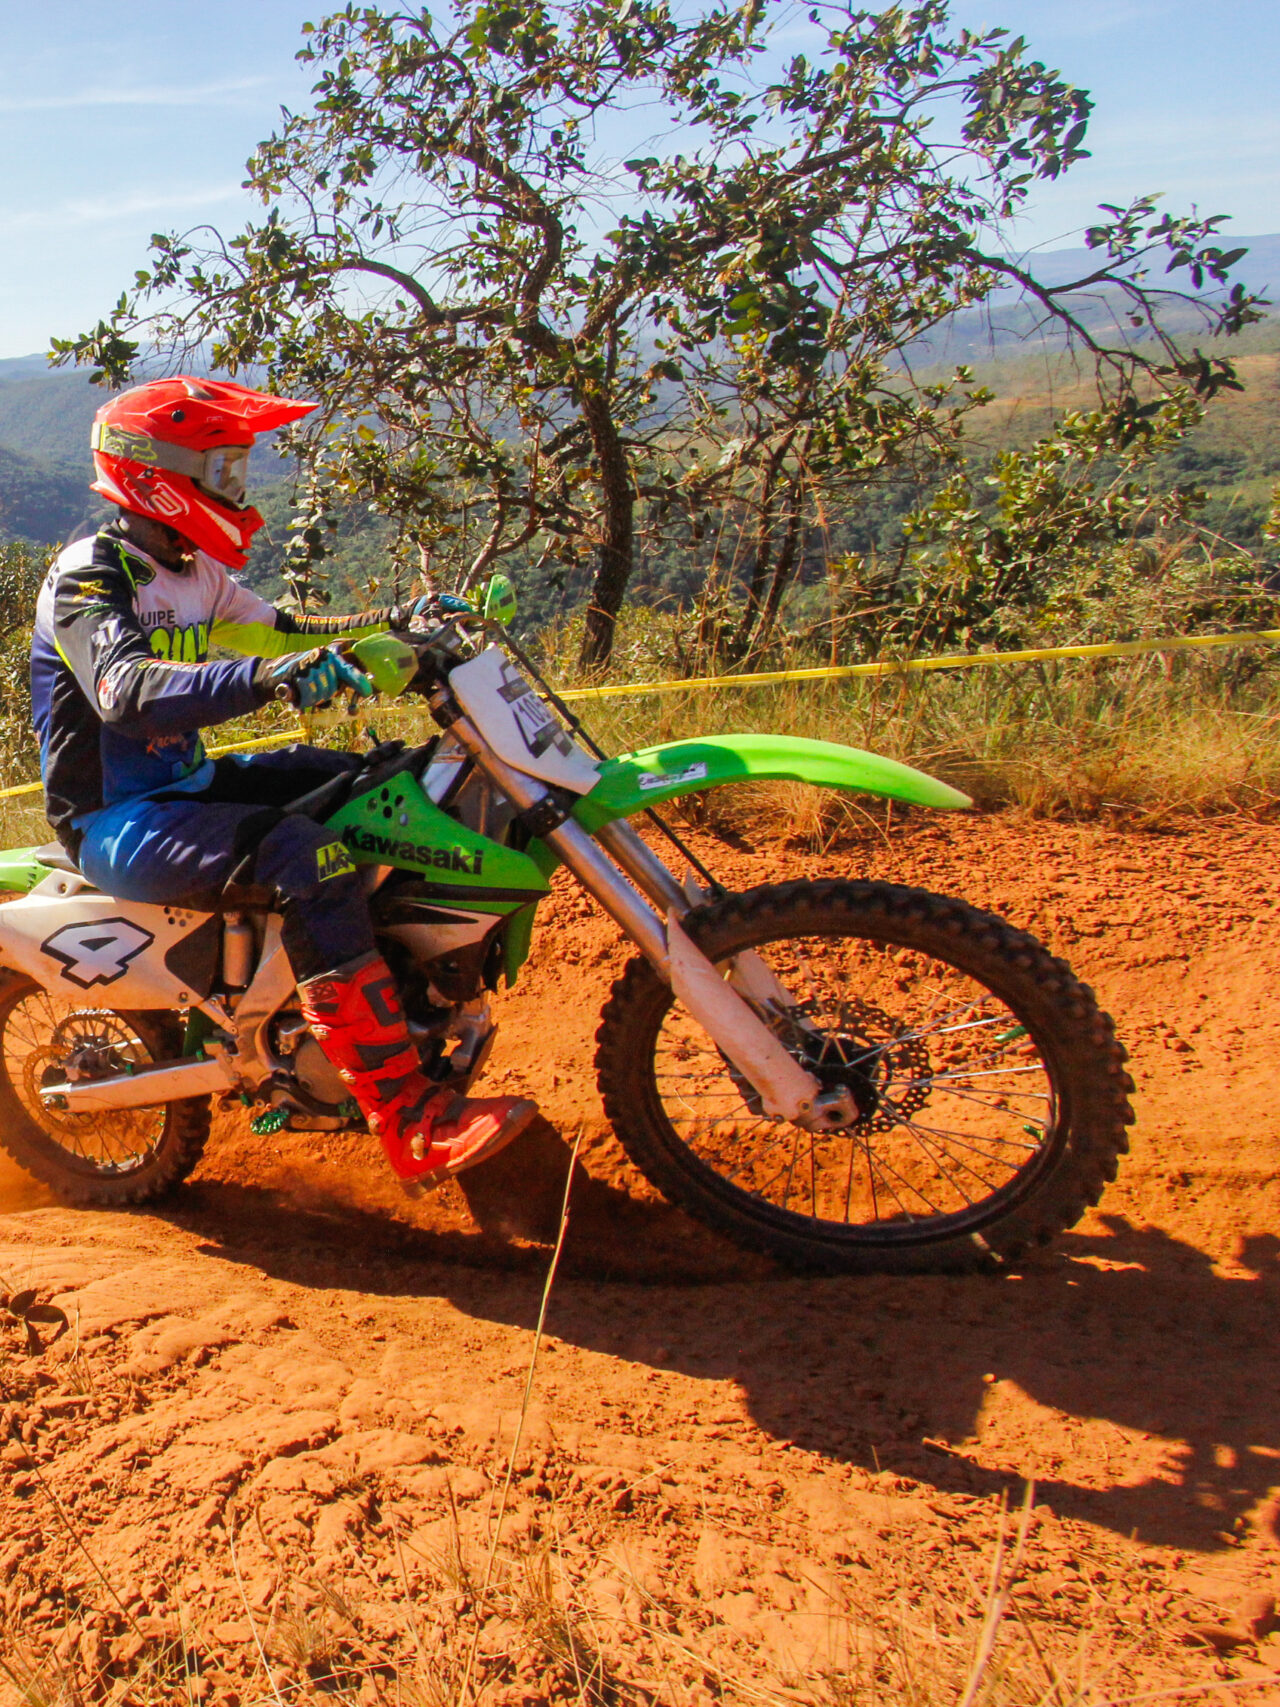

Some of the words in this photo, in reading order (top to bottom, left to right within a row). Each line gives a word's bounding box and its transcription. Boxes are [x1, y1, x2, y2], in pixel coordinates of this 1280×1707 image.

[140, 609, 176, 627] UIPE
[341, 824, 484, 876] Kawasaki
[40, 916, 156, 990] 4
